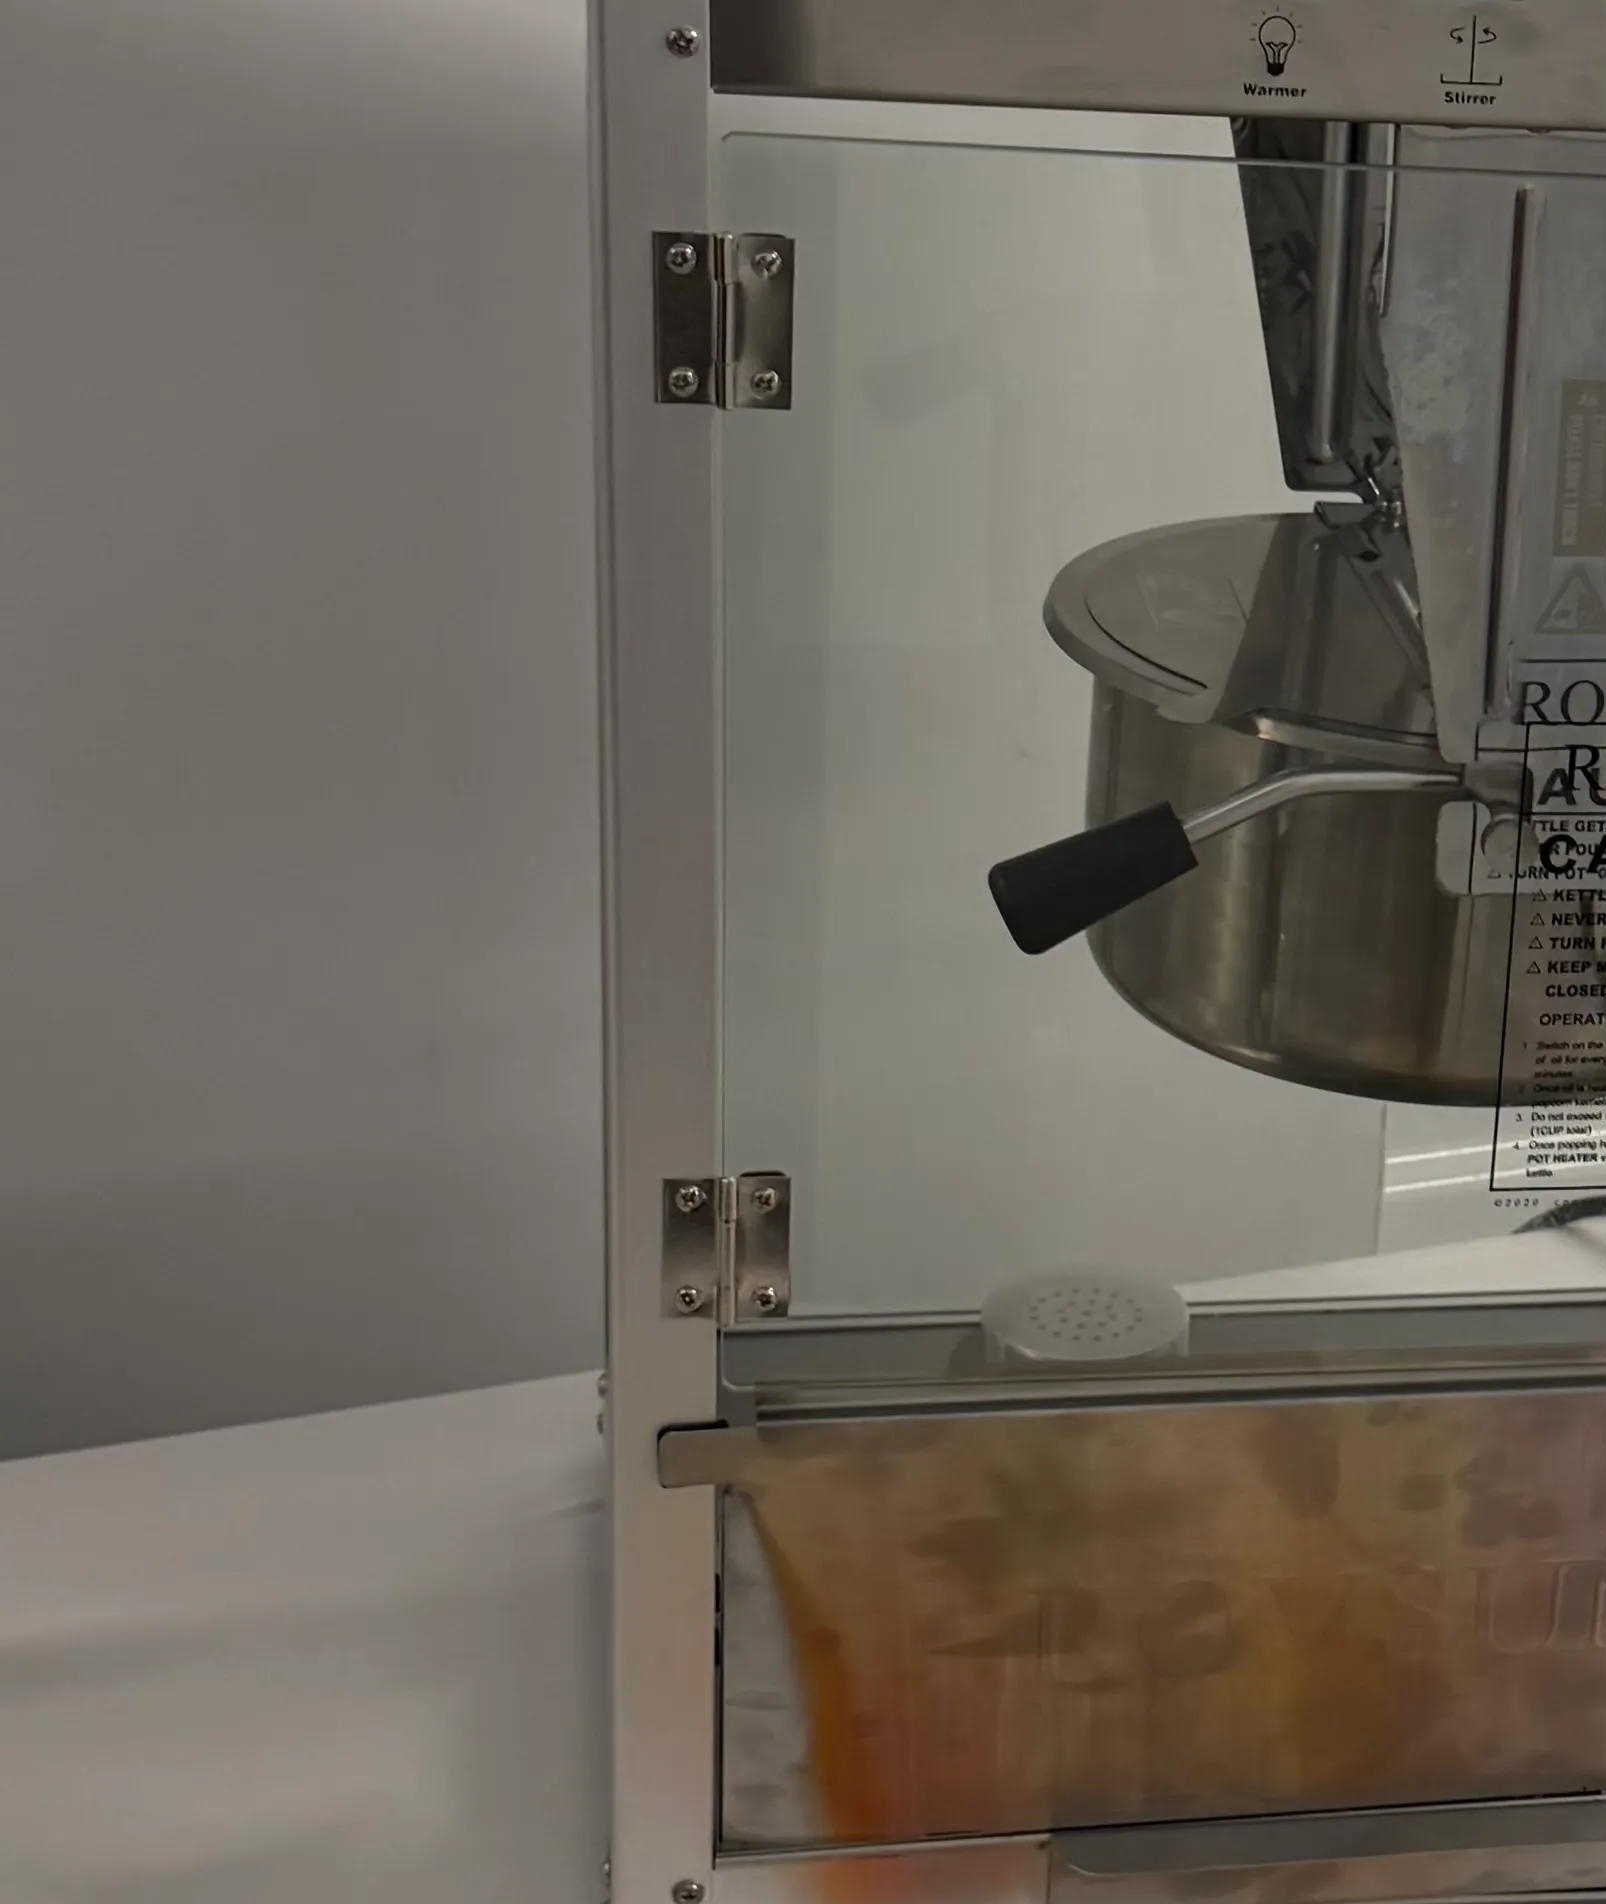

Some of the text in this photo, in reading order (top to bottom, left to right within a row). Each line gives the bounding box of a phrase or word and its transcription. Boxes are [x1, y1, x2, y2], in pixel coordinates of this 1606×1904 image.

[1243, 81, 1308, 100] Warmer
[1444, 90, 1498, 107] Stirrer
[1549, 936, 1600, 951] TURN
[1547, 960, 1592, 974] KEEP
[1526, 1152, 1551, 1164] POT
[1552, 1151, 1599, 1163] HEATER
